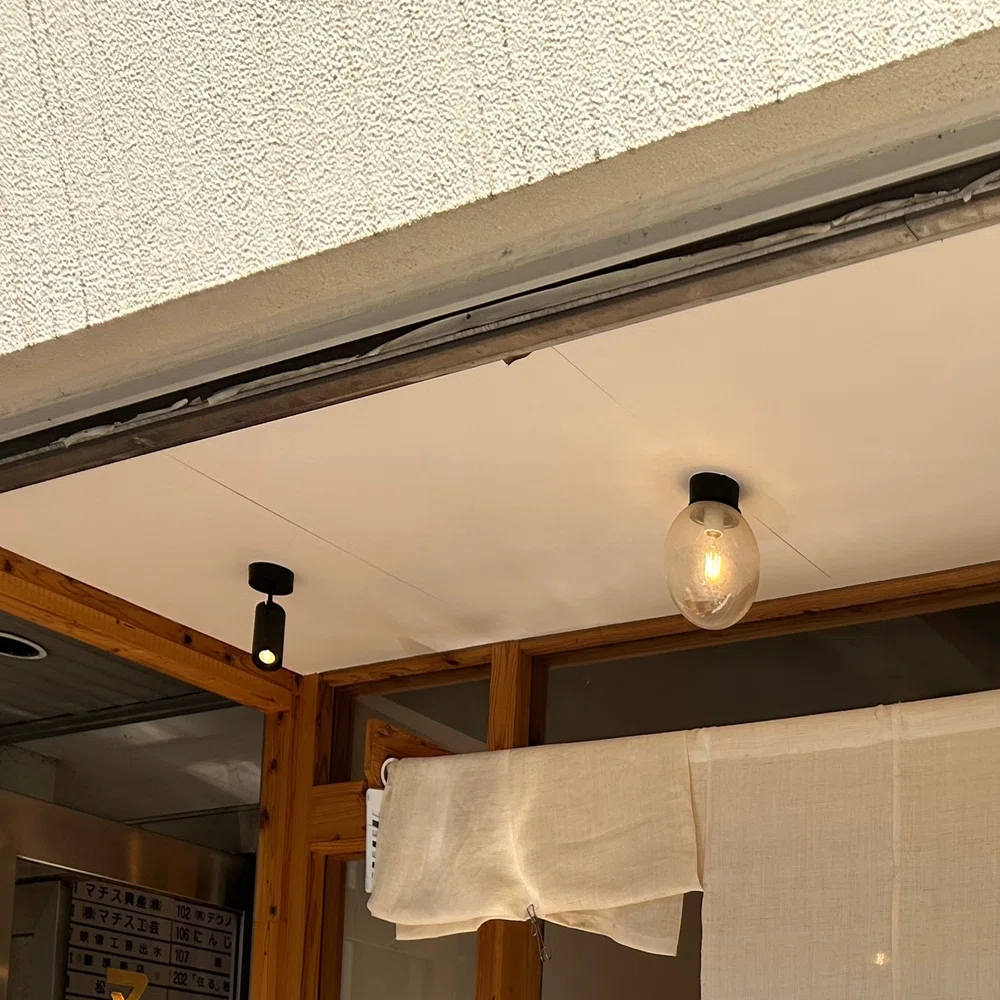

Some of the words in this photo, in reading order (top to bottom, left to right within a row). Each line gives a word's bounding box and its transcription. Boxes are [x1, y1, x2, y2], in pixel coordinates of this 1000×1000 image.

[176, 904, 191, 920] 102
[175, 926, 190, 942] 106
[175, 949, 190, 964] 107
[173, 971, 188, 986] 202
